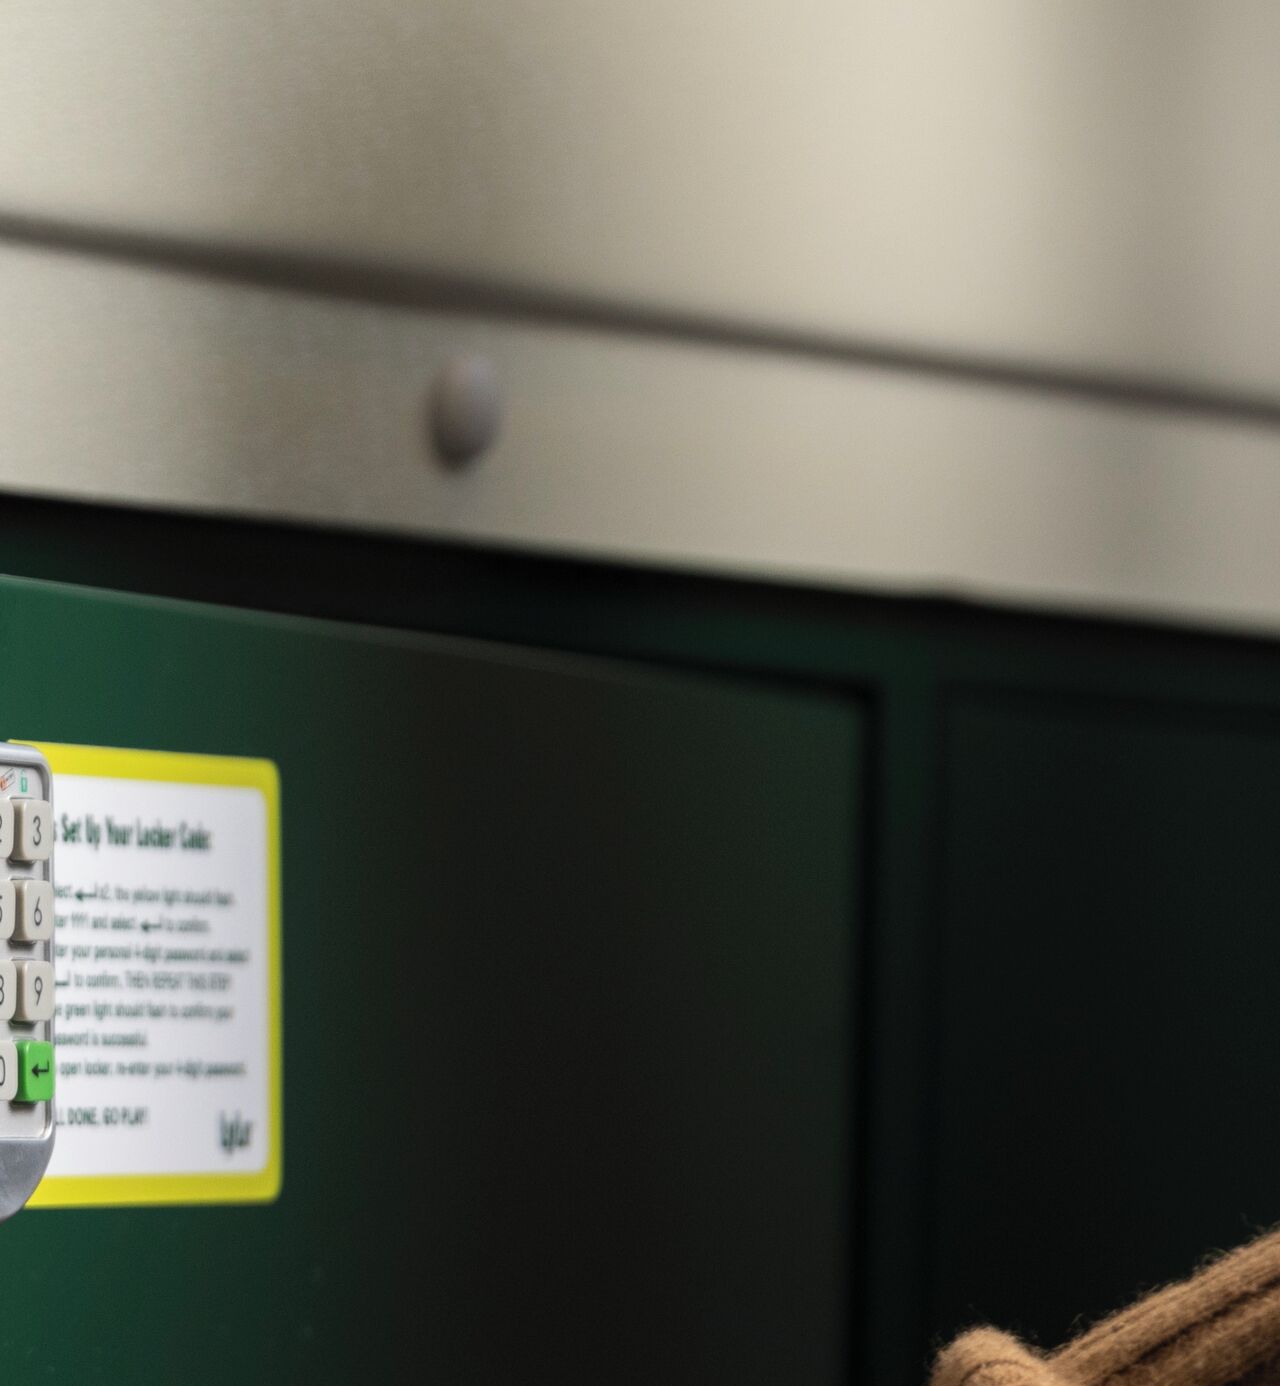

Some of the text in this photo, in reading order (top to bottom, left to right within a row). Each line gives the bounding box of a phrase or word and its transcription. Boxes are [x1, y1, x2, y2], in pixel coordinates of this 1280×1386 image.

[32, 815, 42, 847] 3
[61, 812, 81, 843] Set
[85, 813, 100, 850] Up
[105, 814, 132, 846] Your
[33, 898, 43, 927] 6
[34, 976, 43, 1005] 9
[102, 1107, 118, 1126] GO
